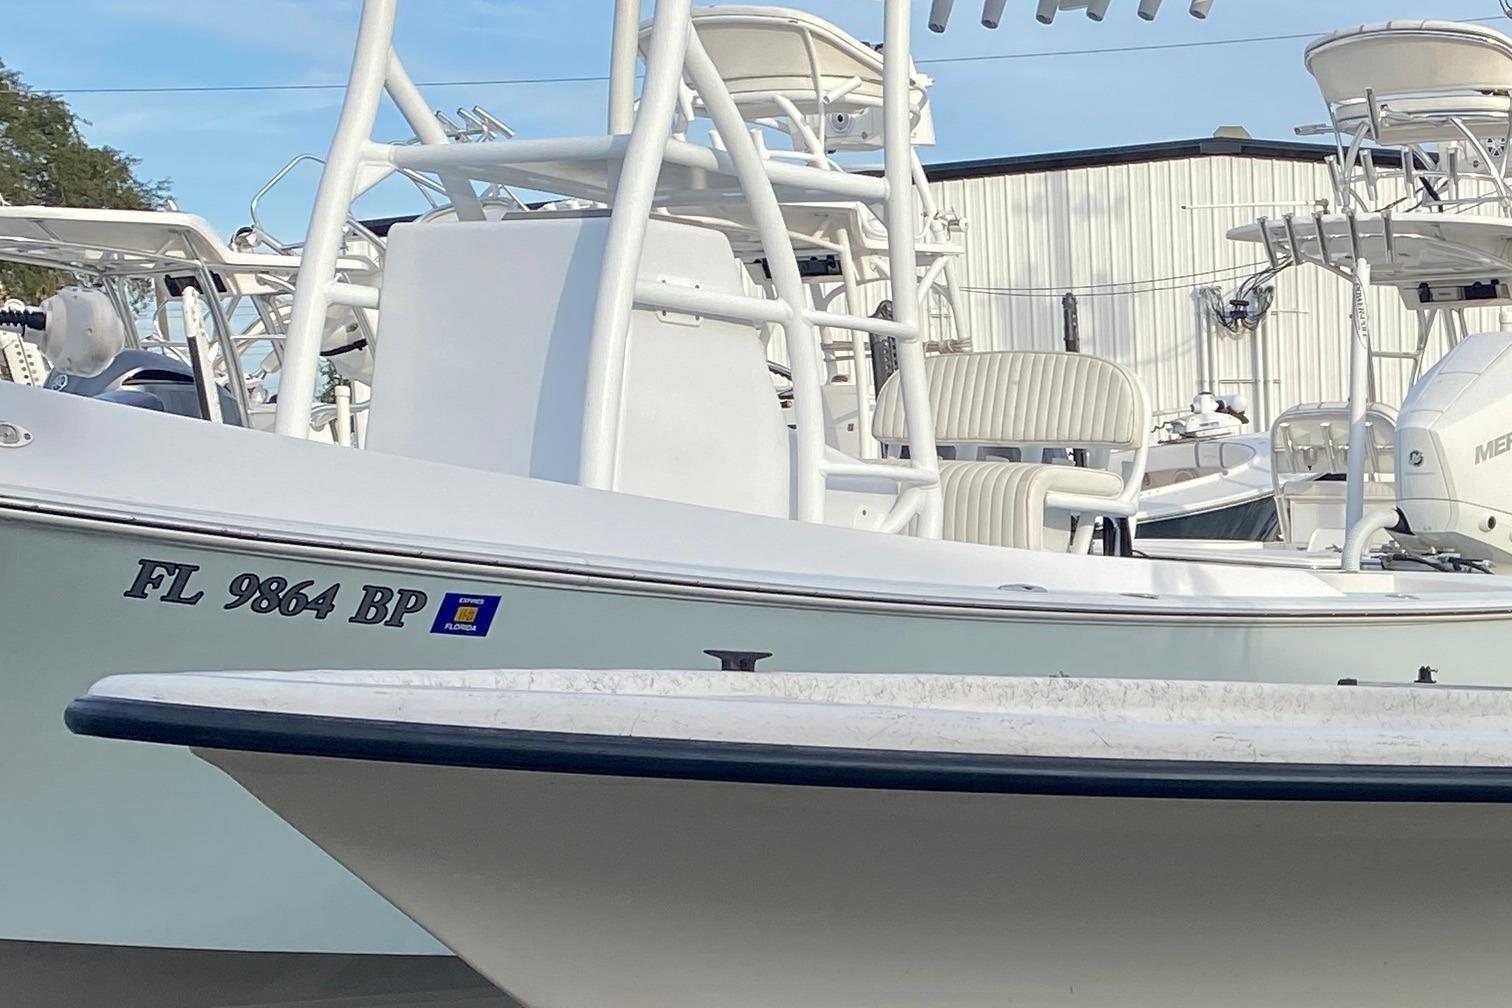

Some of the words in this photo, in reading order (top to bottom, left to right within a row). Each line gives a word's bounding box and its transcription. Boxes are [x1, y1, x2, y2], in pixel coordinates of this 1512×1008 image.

[124, 559, 204, 605] FL
[225, 573, 341, 620] 9864
[348, 585, 428, 628] BP
[444, 623, 477, 631] FLORIDA
